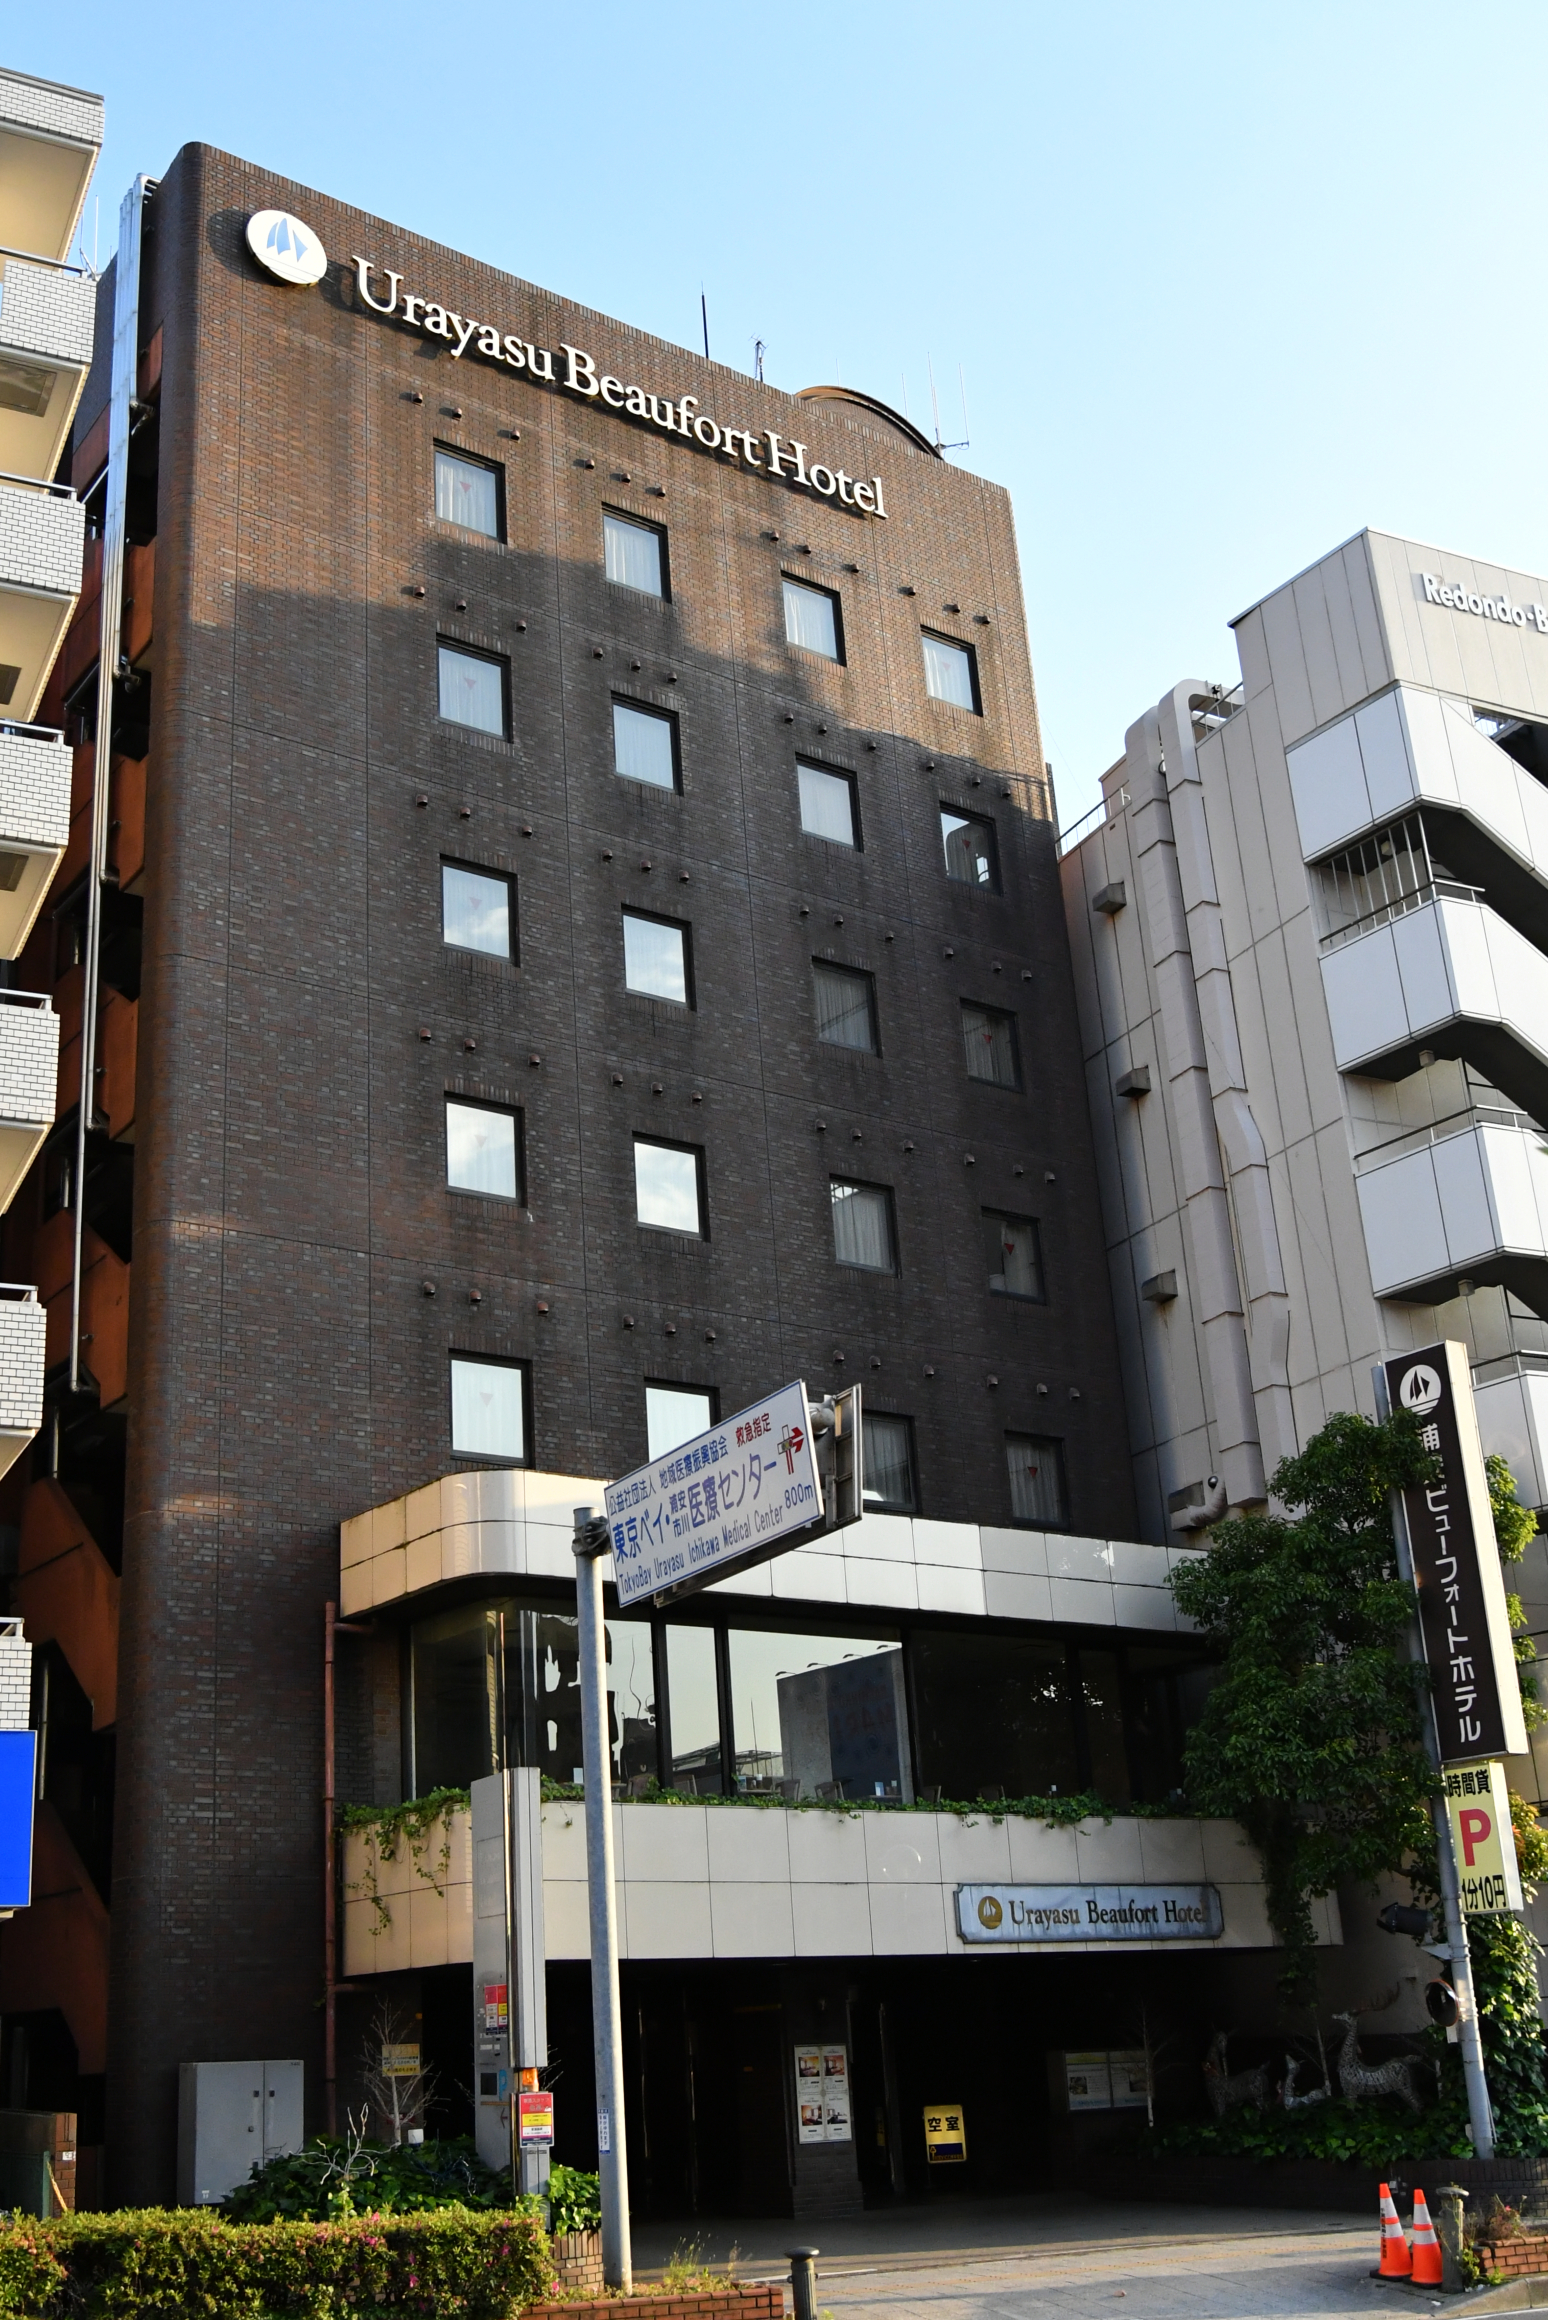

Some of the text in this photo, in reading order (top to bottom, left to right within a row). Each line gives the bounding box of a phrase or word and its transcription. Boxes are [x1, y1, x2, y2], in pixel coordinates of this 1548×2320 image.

[352, 254, 889, 520] Urayasu Beaufort Hotel
[608, 1412, 772, 1517] 公益社団法人 地域医療振興協会 救急指定
[687, 1452, 777, 1529] 医療センター
[653, 1551, 684, 1580] Urayasu
[688, 1535, 720, 1564] Ichikawa
[722, 1521, 751, 1549] Medical
[754, 1503, 783, 1534] Center
[784, 1482, 814, 1510] 800m
[672, 1512, 690, 1538] 市川
[1417, 1422, 1482, 1744] 浦ビューフォートホテル
[1446, 1768, 1491, 1798] 時間貸
[1458, 1808, 1492, 1867] P
[1008, 1899, 1208, 1930] Urayasu Beaufort Hotel
[1461, 1874, 1507, 1912] 1分10円
[927, 2115, 960, 2133] 空室
